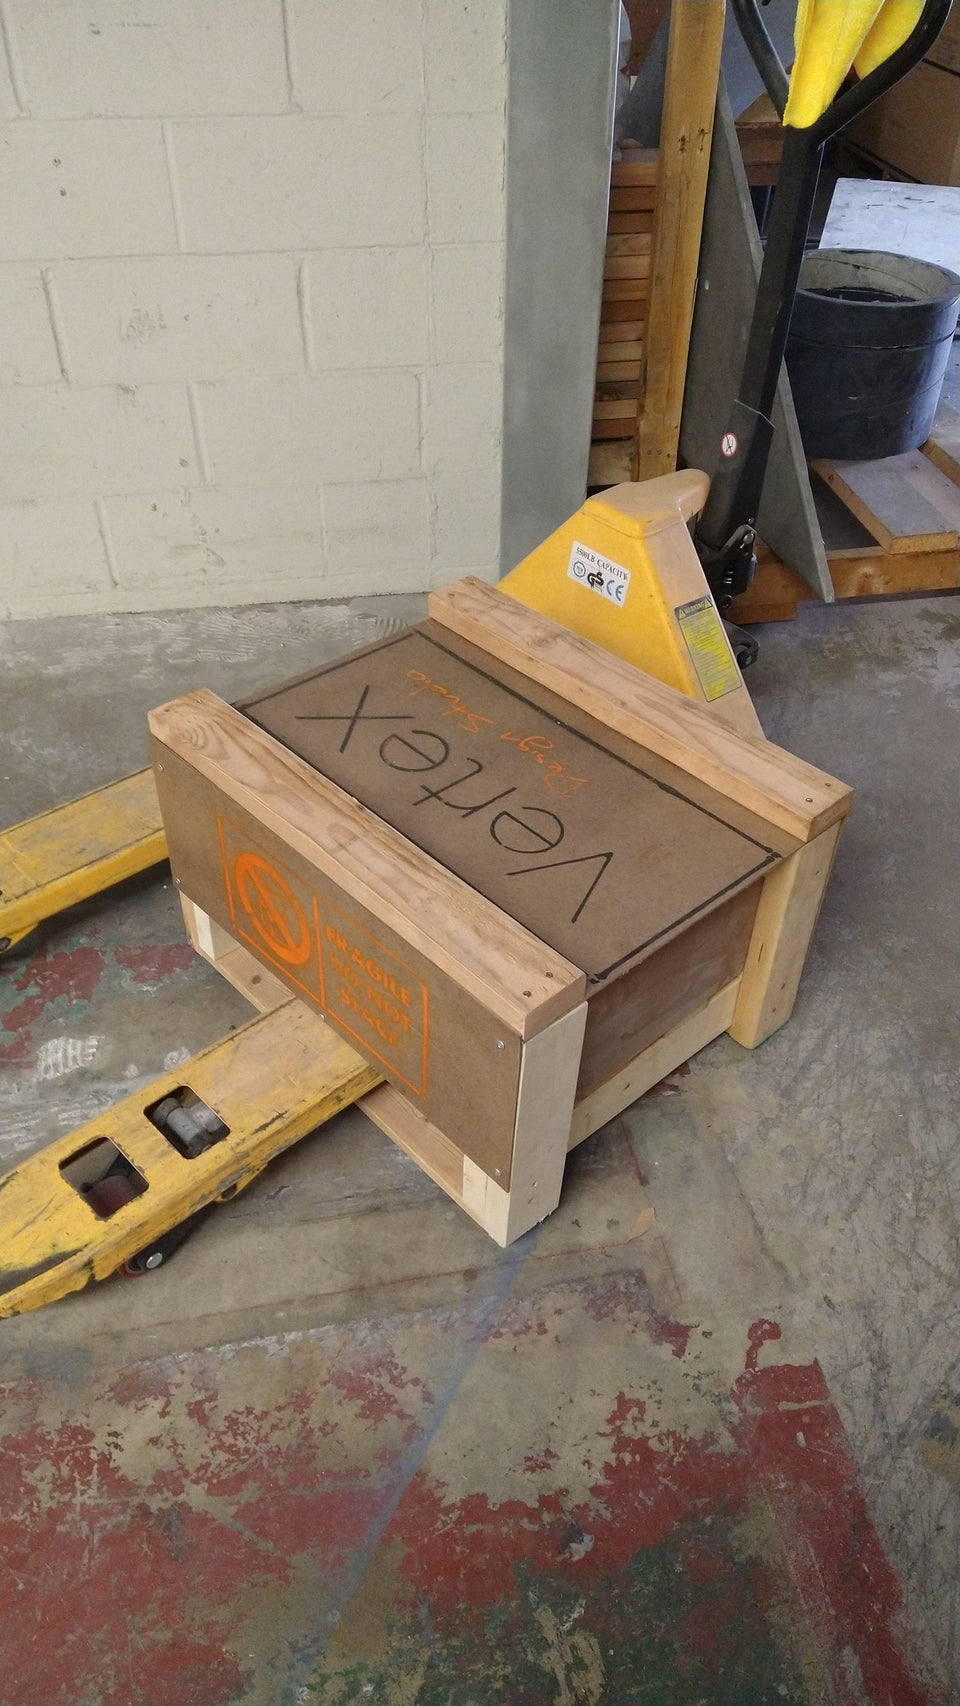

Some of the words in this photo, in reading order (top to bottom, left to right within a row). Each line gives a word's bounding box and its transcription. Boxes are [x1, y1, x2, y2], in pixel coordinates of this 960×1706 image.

[597, 559, 629, 580] CAPACITY
[501, 732, 590, 798] Design
[325, 923, 411, 1009] FRAGILE
[329, 952, 360, 990] DO
[366, 980, 411, 1033] NOT
[340, 988, 401, 1050] STACK
